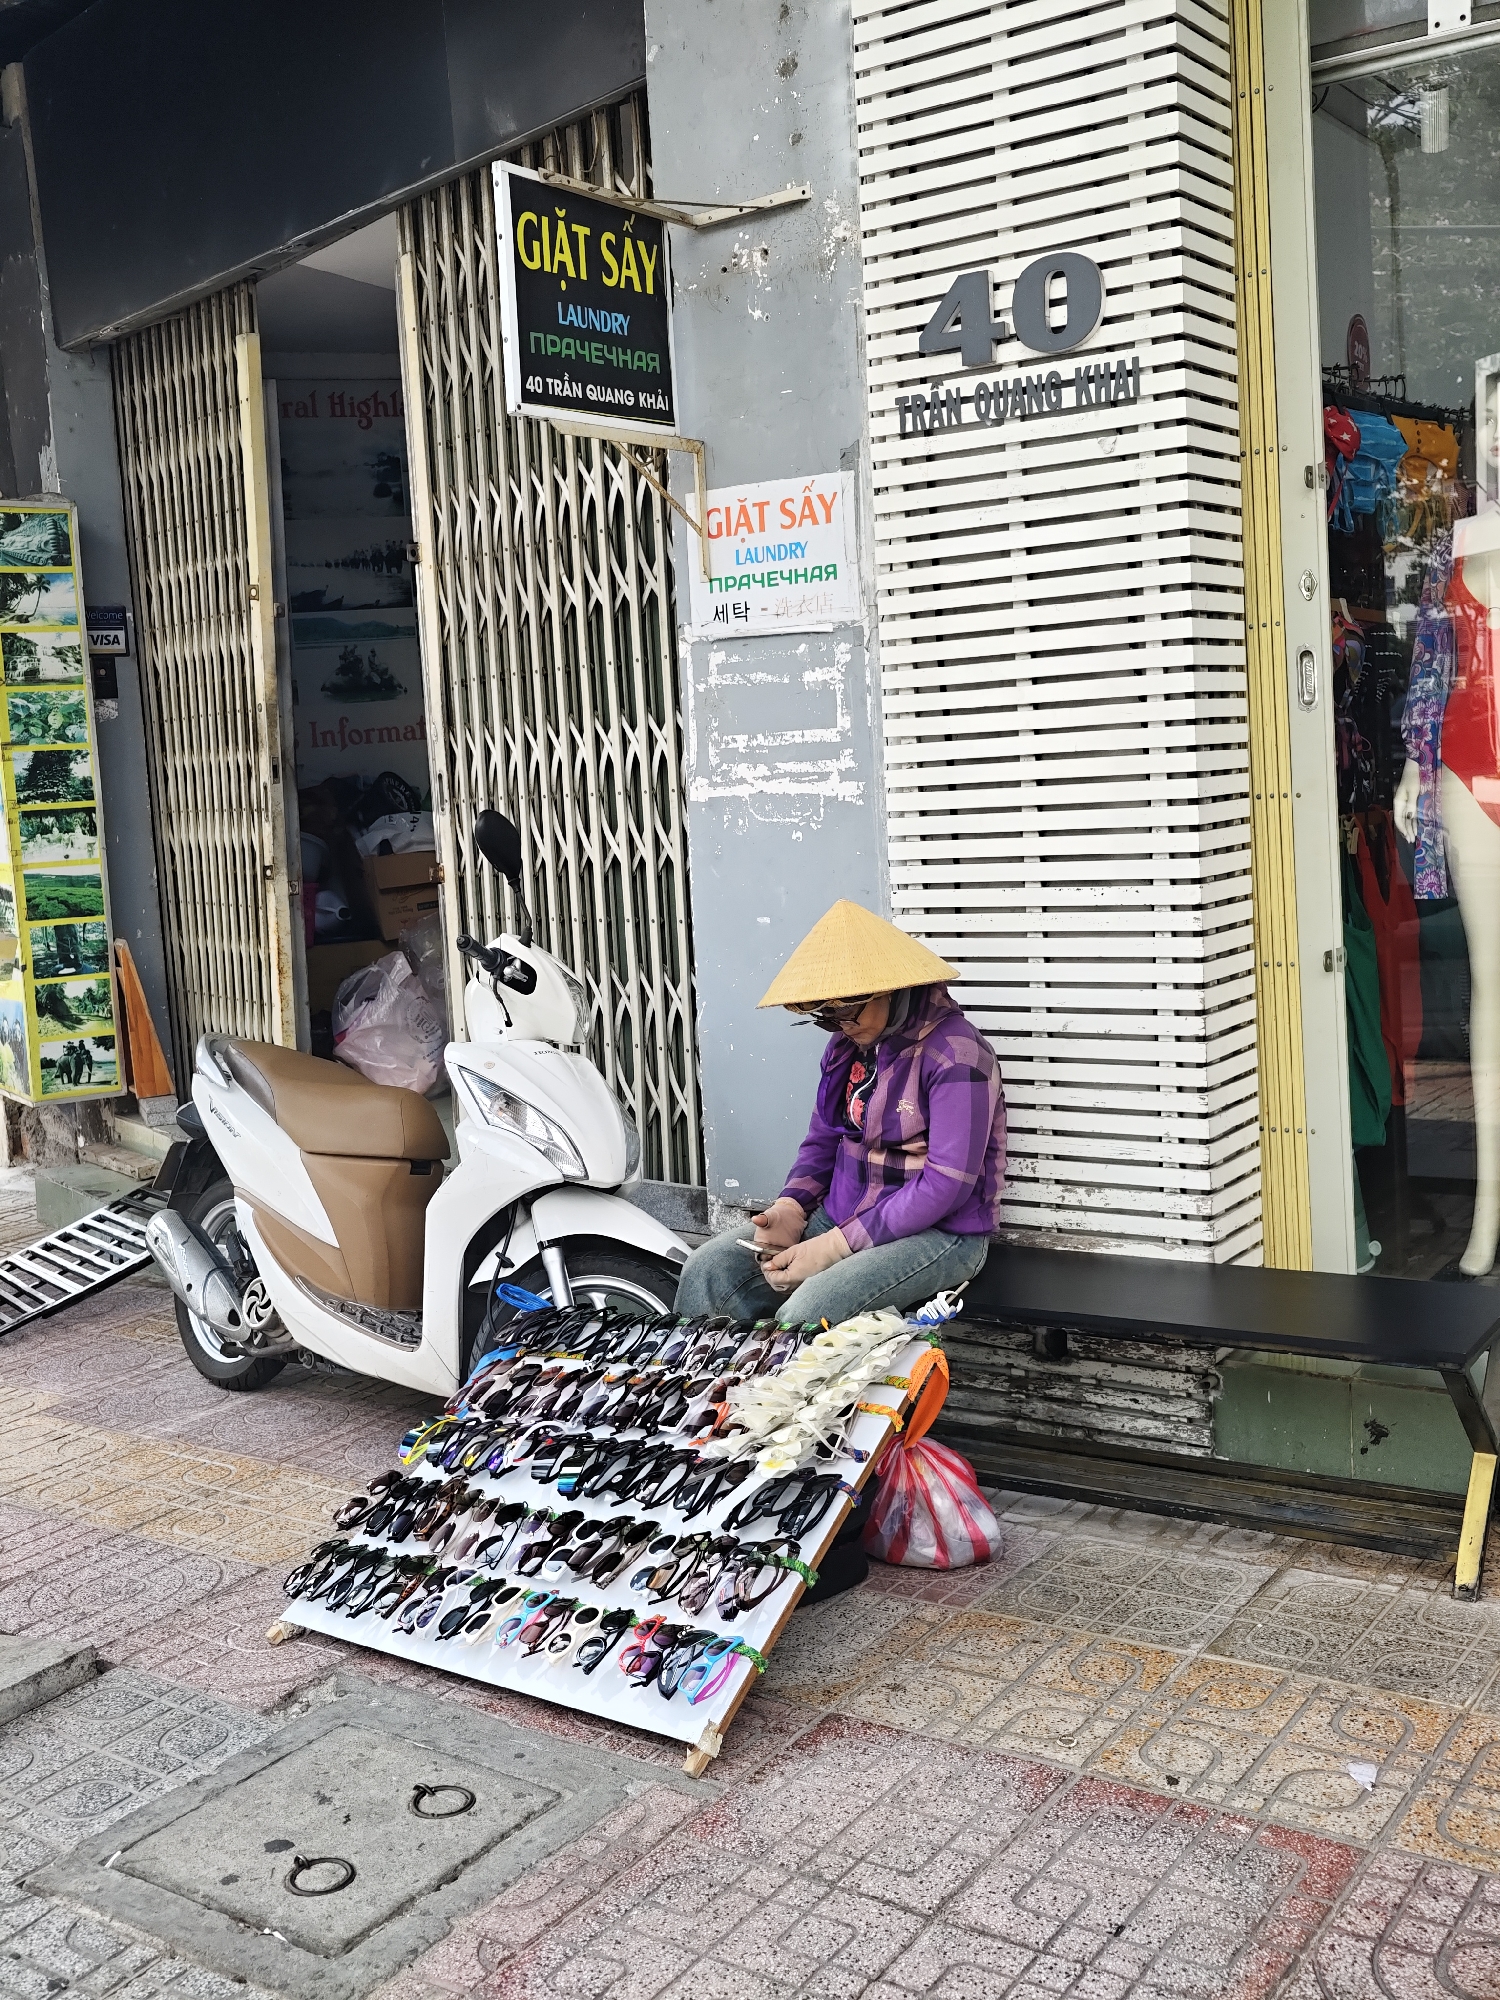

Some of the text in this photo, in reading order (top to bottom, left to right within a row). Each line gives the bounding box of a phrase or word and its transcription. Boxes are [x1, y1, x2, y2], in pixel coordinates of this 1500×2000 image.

[517, 206, 658, 295] GIẶT SẤY
[557, 301, 631, 337] LAUNDRY
[918, 252, 1106, 367] 40
[529, 331, 661, 374] ПРАЧЕЧНАЯ
[281, 389, 319, 418] ral
[525, 372, 669, 411] 40 TRẦN QUANG KHẢI
[974, 370, 1063, 427] QUANG
[1074, 356, 1141, 407] KHAI
[706, 479, 838, 544] GIẶT SẤY
[735, 541, 809, 566] LAUNDRY
[709, 563, 838, 594] ПРАЧЕЧНАЯ
[713, 600, 751, 625] 세탁
[774, 591, 834, 619] 洗衣店
[89, 634, 121, 646] VISA
